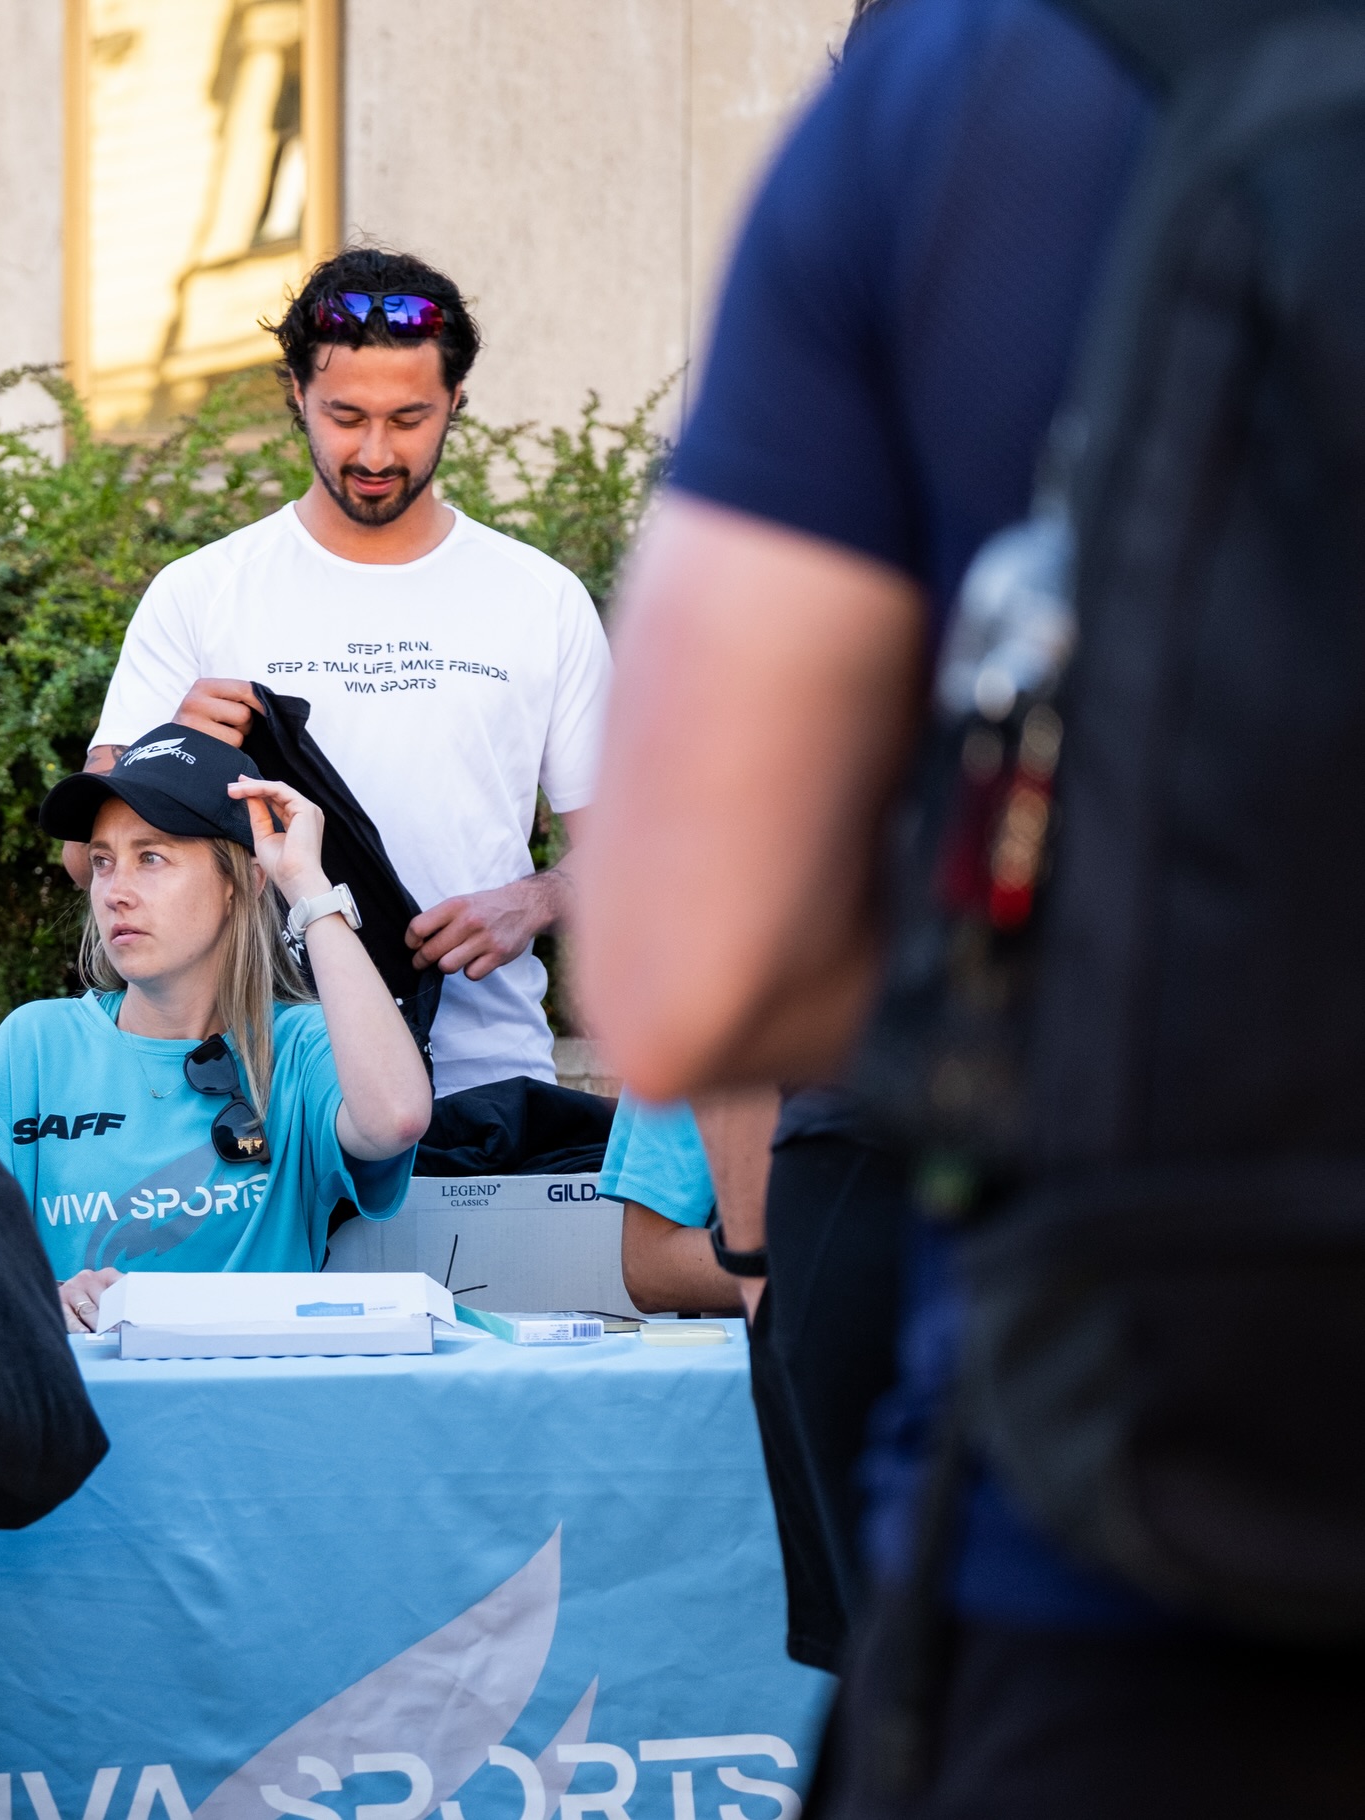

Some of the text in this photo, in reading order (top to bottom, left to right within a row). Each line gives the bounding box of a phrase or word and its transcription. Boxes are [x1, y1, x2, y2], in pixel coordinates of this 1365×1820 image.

[347, 641, 433, 655] STEP 1: RUN.
[267, 661, 303, 674] STEP
[307, 661, 319, 672] 2:
[323, 661, 359, 673] TALK
[401, 659, 444, 671] MAKE
[344, 678, 437, 694] VIVA SPORTS
[12, 1112, 126, 1145] SAFF
[41, 1172, 270, 1227] VIVA SPORTS
[450, 1198, 489, 1207] CLASSICS
